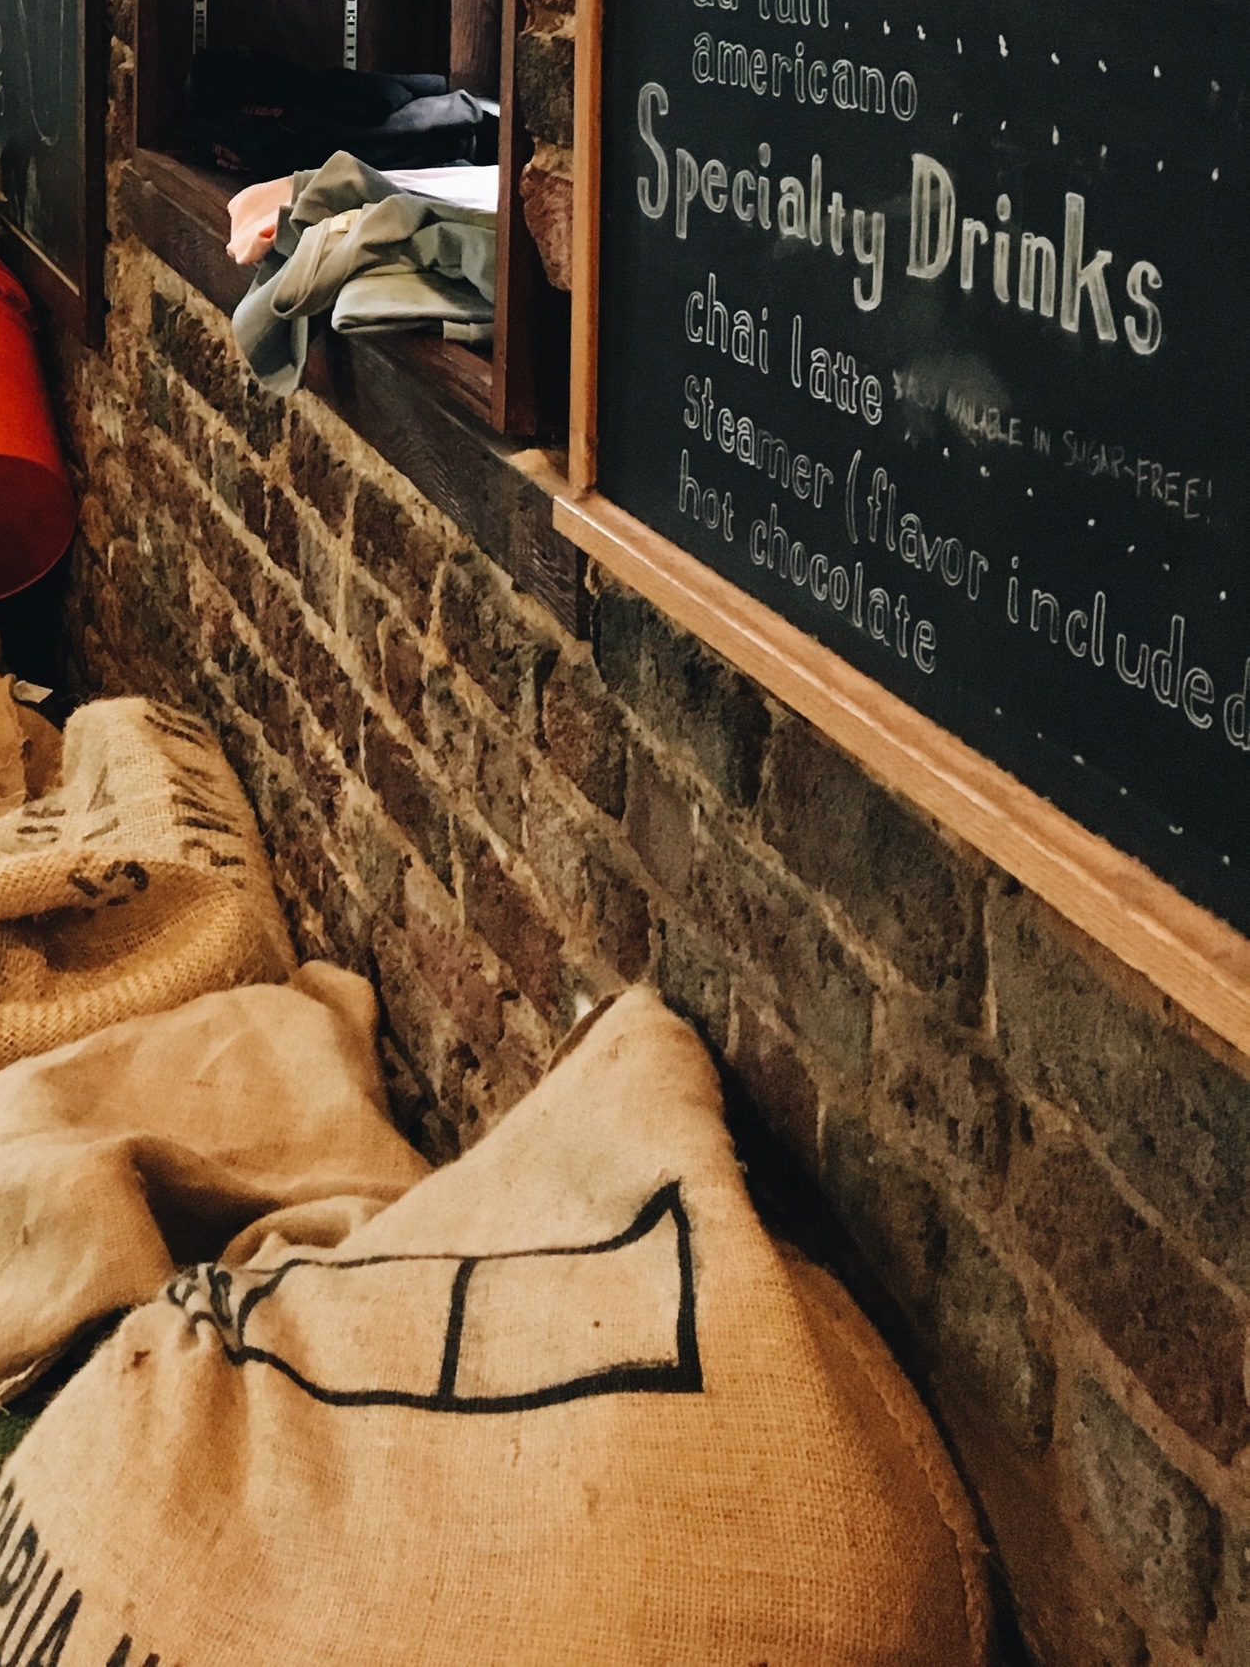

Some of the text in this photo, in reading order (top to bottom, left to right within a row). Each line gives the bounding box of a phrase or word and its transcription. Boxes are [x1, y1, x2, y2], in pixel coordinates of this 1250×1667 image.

[692, 31, 918, 121] americano
[636, 81, 1164, 356] Specialty Drinks
[685, 271, 770, 375] chai
[791, 314, 883, 425] latte
[678, 449, 937, 675] hot chocolate
[845, 450, 989, 600] (flavor
